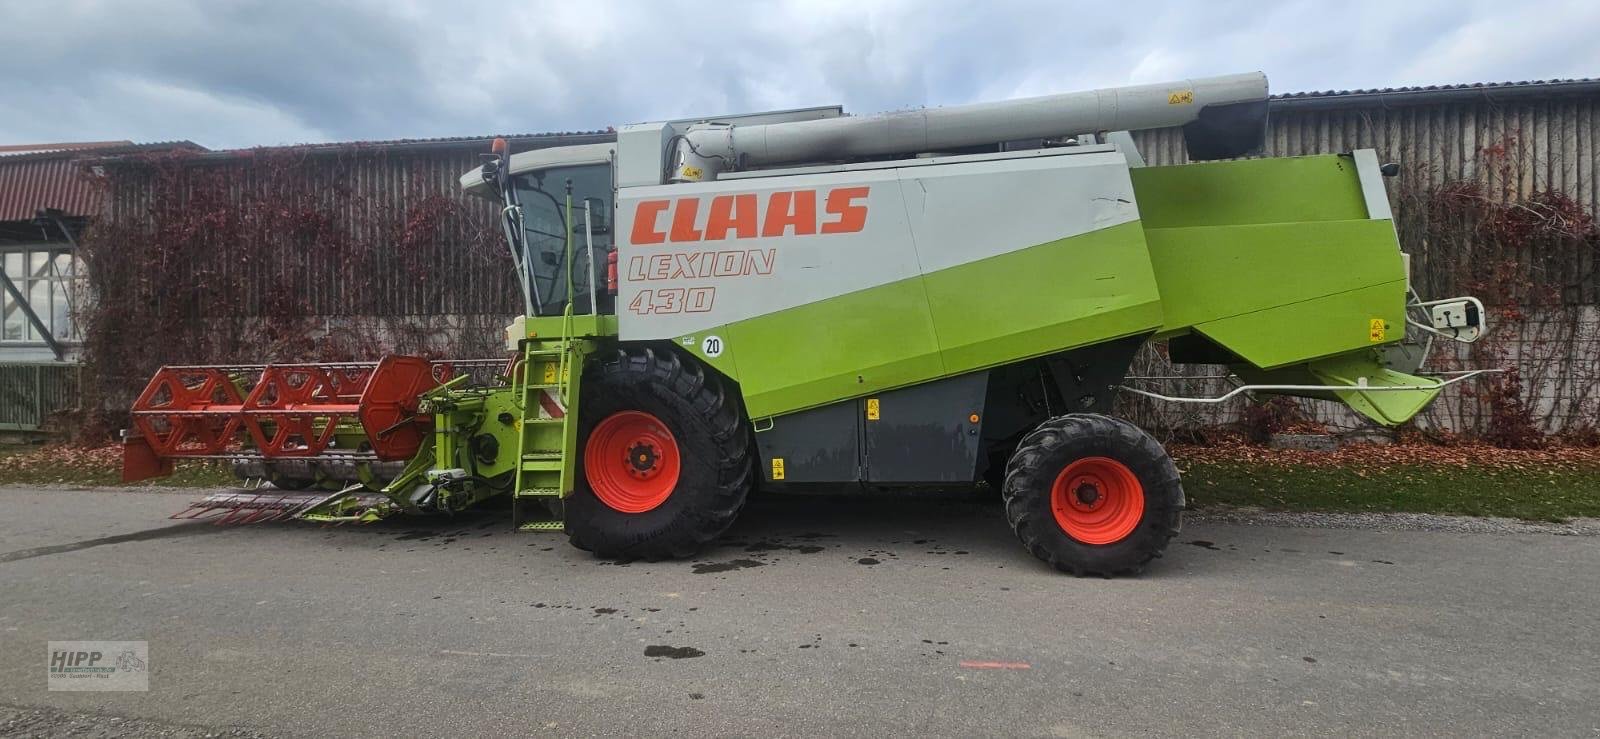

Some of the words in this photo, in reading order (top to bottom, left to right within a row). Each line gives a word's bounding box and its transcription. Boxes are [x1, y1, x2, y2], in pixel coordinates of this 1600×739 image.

[630, 187, 869, 244] CLAAS
[628, 249, 775, 281] LEXION
[629, 287, 716, 314] 430
[706, 339, 720, 353] 20
